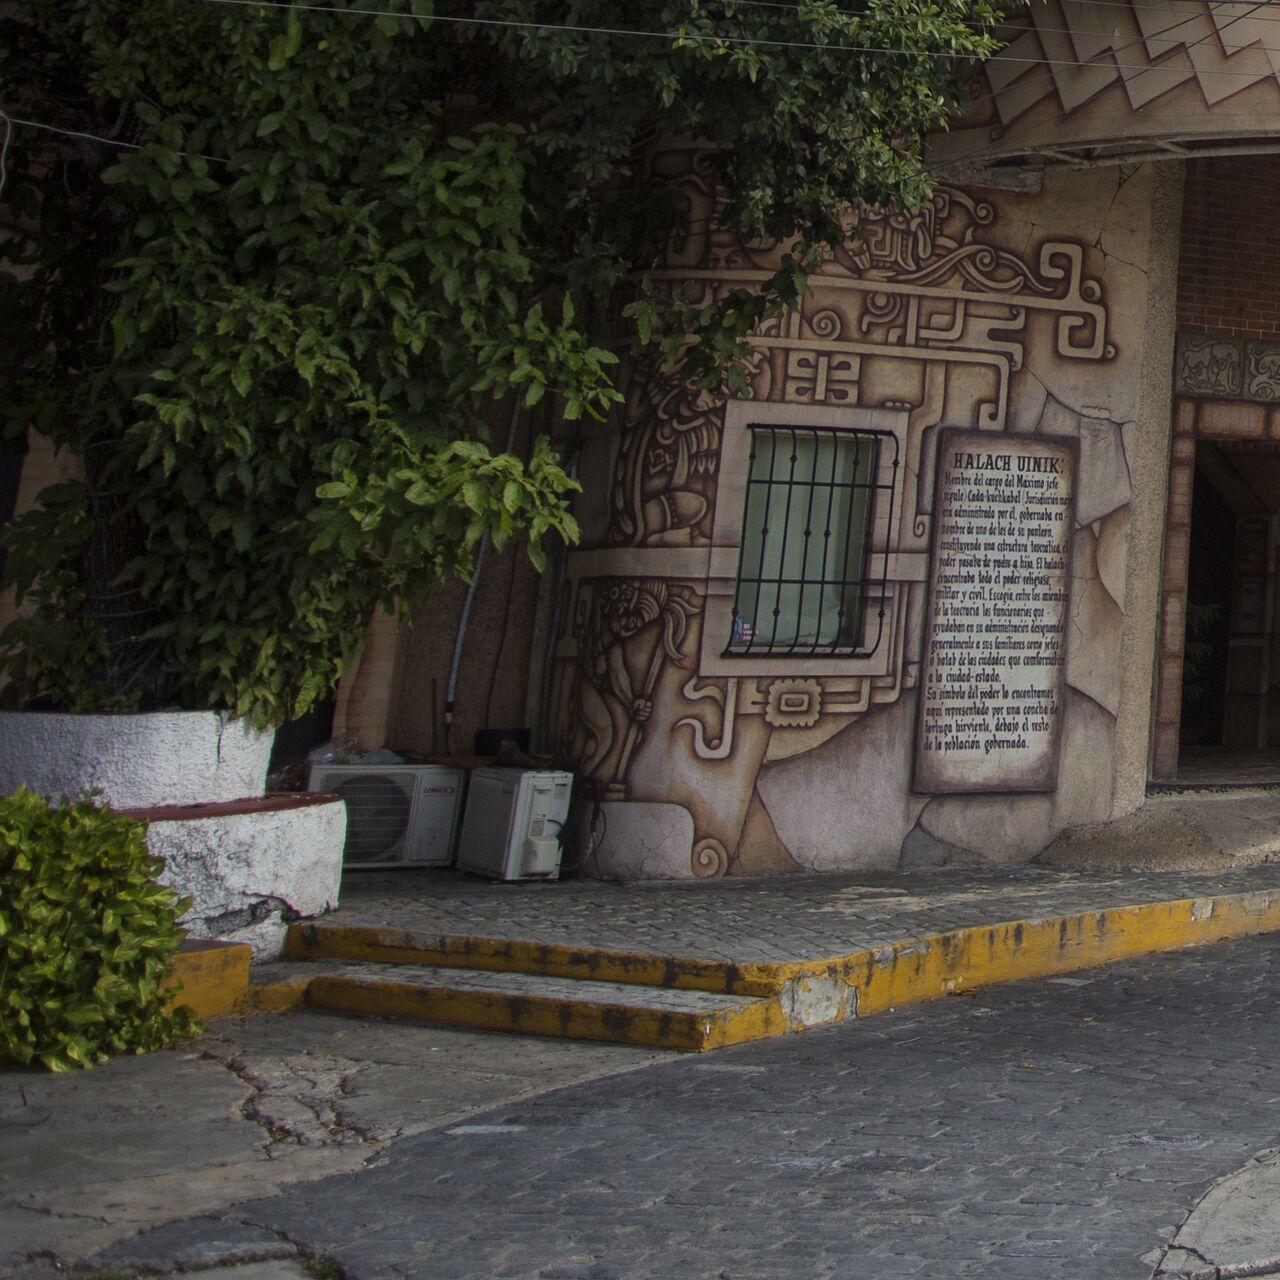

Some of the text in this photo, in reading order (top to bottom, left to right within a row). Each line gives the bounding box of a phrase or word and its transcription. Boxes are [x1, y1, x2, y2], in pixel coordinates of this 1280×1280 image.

[953, 453, 1064, 473] HALACH UINIK:
[945, 472, 971, 486] Nombre
[974, 474, 983, 485] del
[985, 478, 1002, 490] cargo
[1005, 475, 1014, 487] del
[967, 522, 974, 533] de
[989, 523, 996, 535] de
[1008, 523, 1015, 535] de
[968, 686, 978, 699] del
[980, 685, 1000, 703] poder
[992, 706, 1004, 719] por
[1007, 706, 1020, 715] una
[1023, 702, 1048, 715] concha
[1022, 718, 1028, 732] el
[1032, 717, 1049, 731] resto
[935, 736, 942, 750] la
